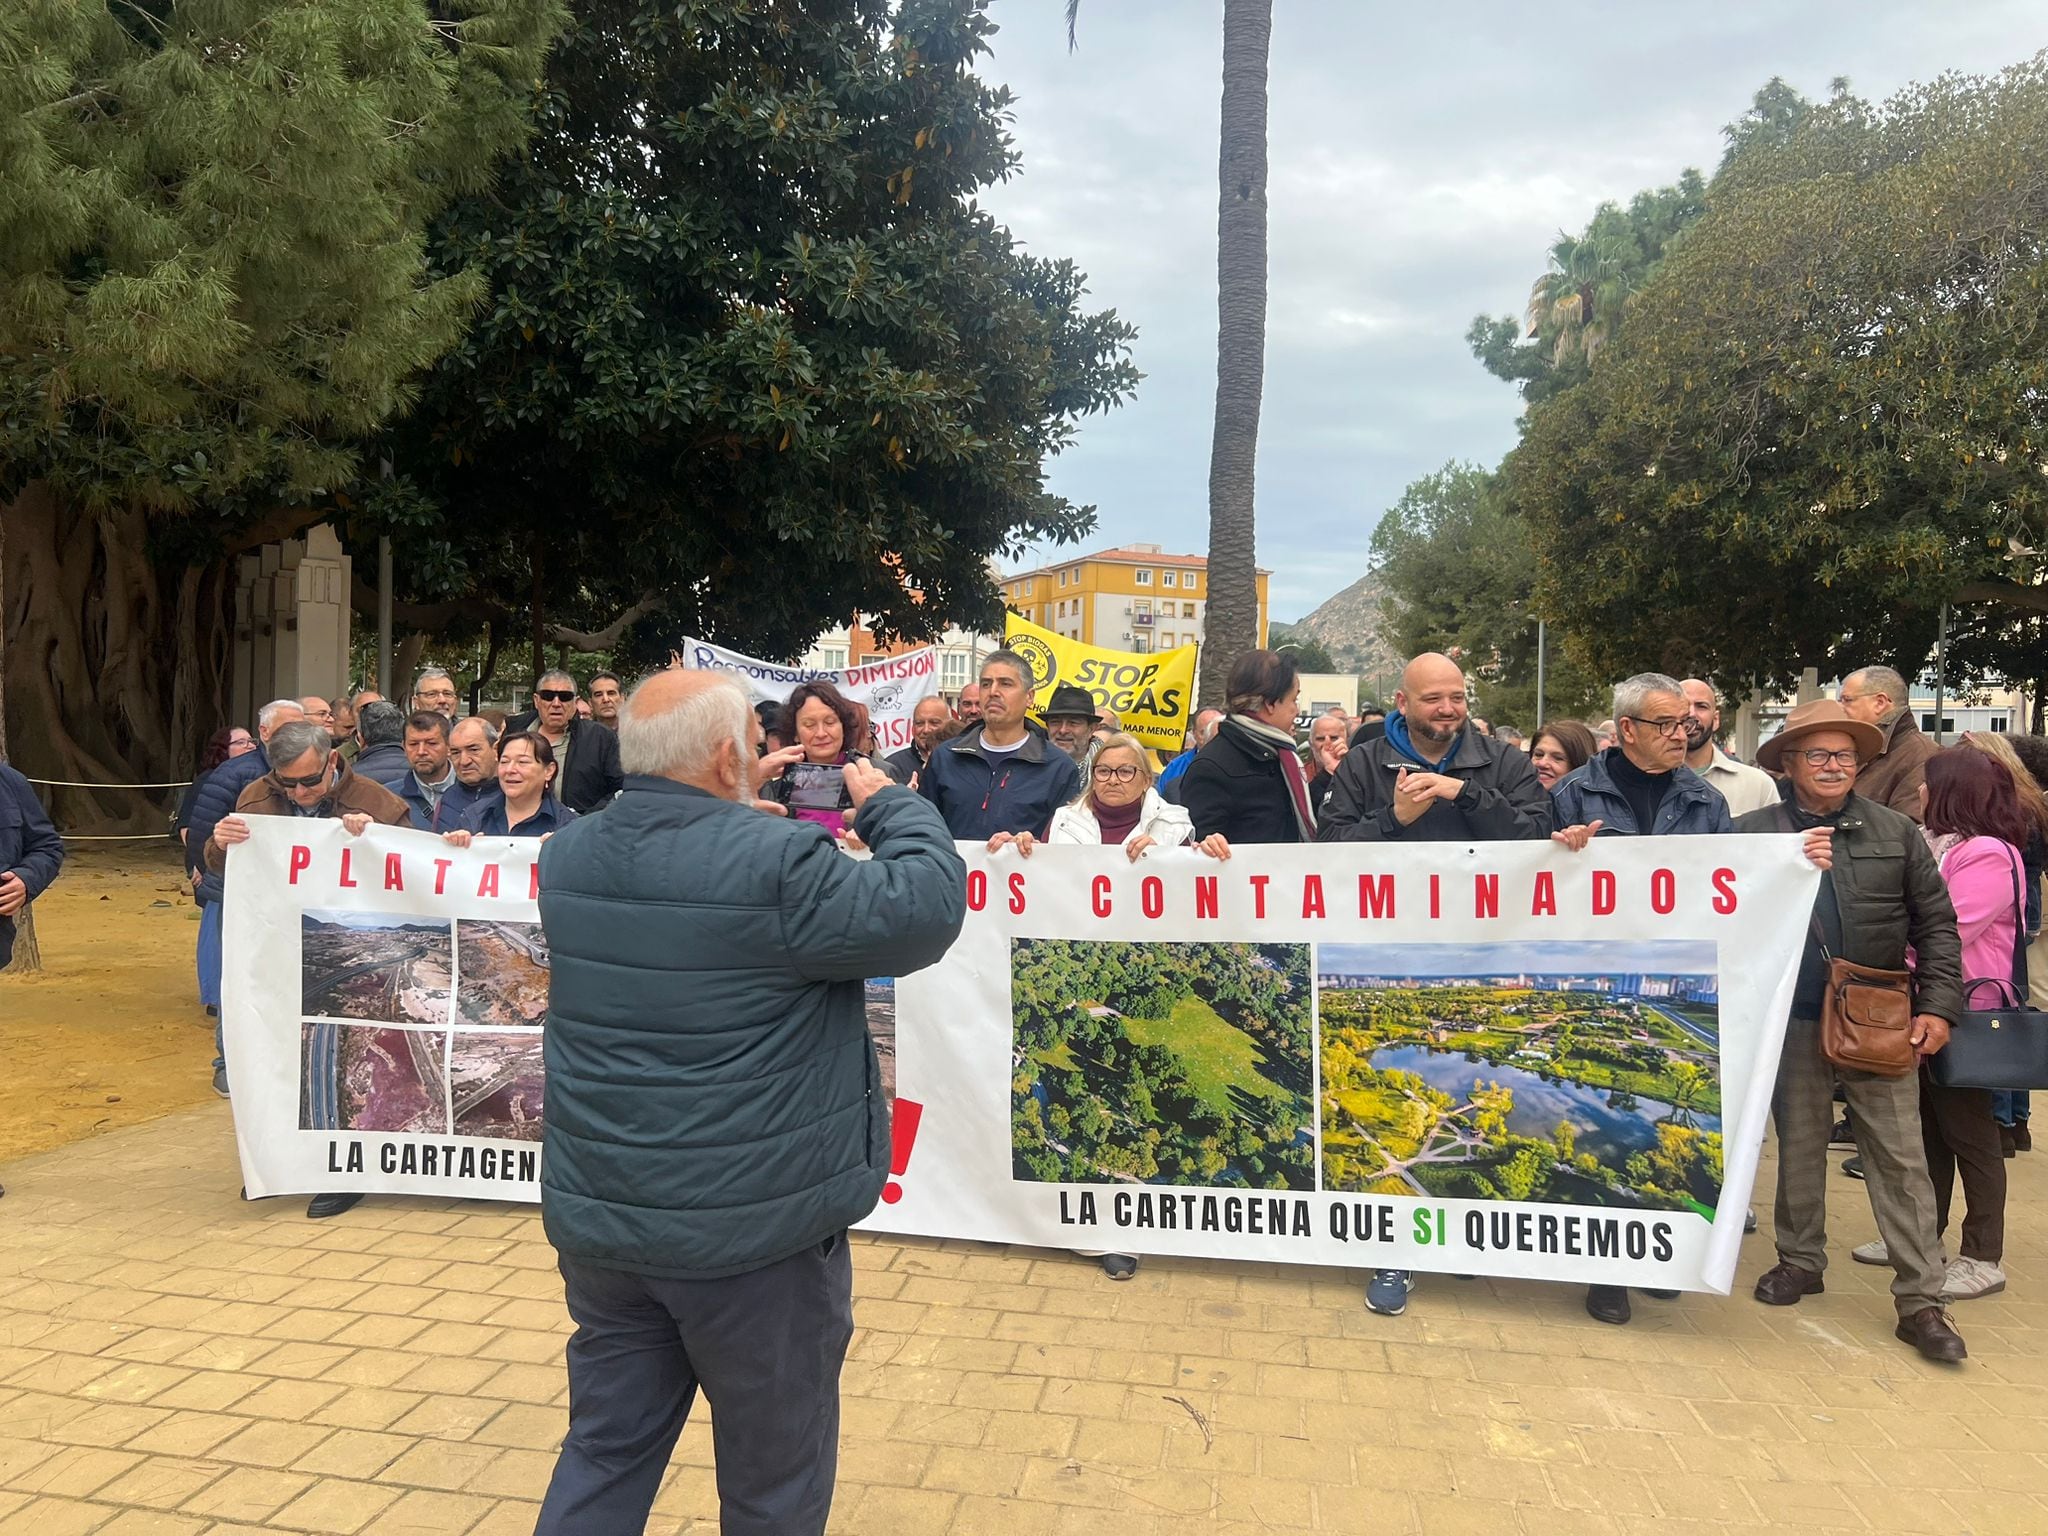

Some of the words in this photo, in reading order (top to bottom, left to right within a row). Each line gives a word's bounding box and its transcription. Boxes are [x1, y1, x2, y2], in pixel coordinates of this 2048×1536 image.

[1009, 635, 1026, 646] STOP
[1075, 659, 1159, 688] STOP
[1058, 679, 1181, 718] OGÁS
[1123, 723, 1145, 734] MAR
[1147, 726, 1181, 738] MENOR
[1091, 867, 1738, 920] CONTAMINADOS
[328, 1141, 364, 1173] LA
[380, 1142, 542, 1183] CARTAGEN
[1060, 1191, 1097, 1226] LA
[1114, 1191, 1311, 1237] CARTAGENA
[1329, 1202, 1394, 1243] QUE
[1414, 1208, 1446, 1246] SI
[1465, 1210, 1674, 1262] QUEREMOS
